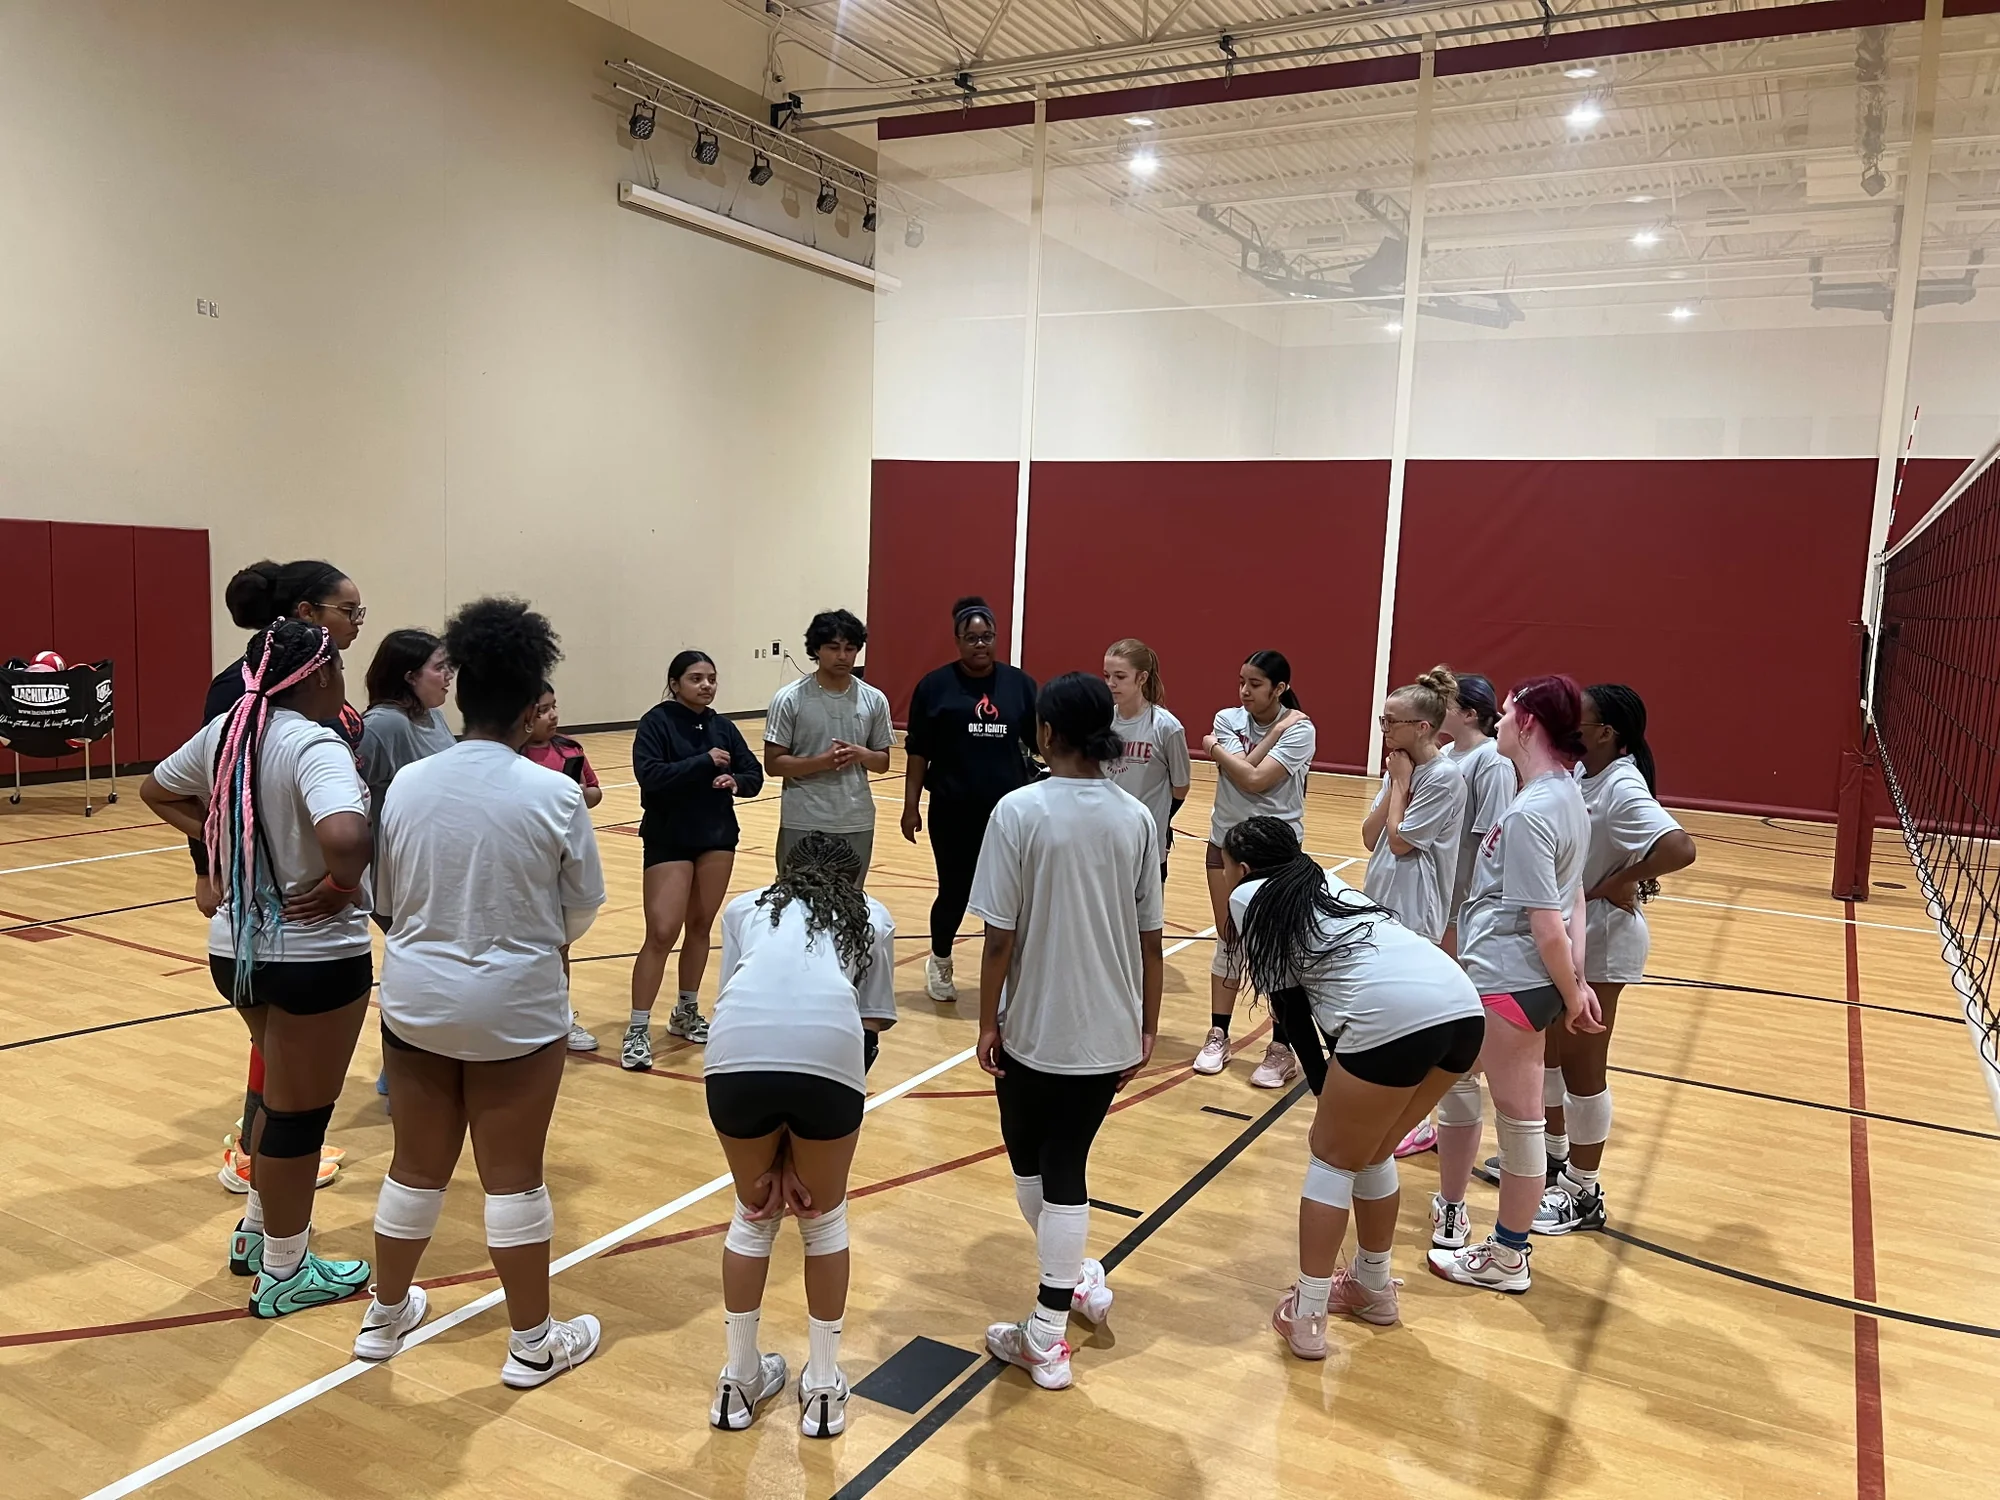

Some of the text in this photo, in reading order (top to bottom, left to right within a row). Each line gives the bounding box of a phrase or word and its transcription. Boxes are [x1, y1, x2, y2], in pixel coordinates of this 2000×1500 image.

[13, 686, 68, 703] TACHIKARA
[968, 723, 1008, 734] OKC IGNITE
[1123, 741, 1153, 758] NITE
